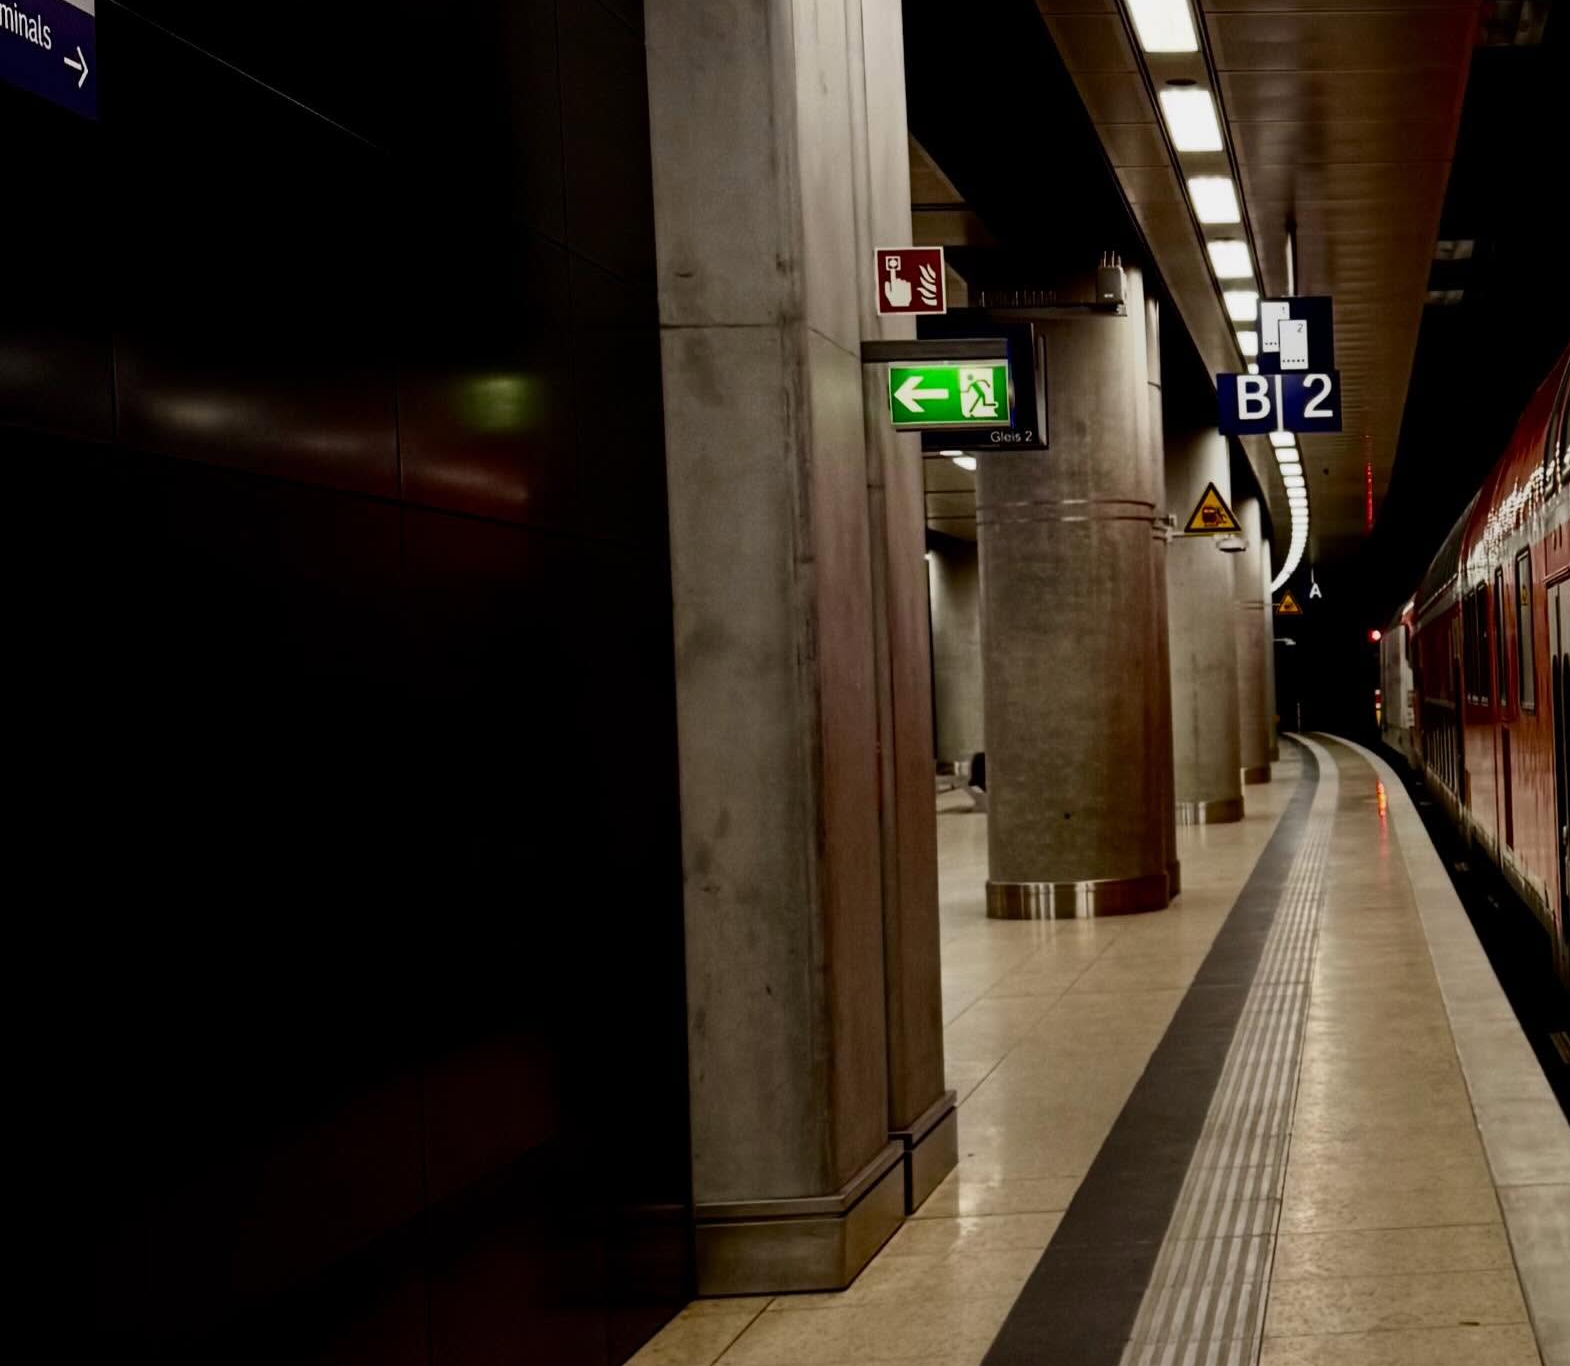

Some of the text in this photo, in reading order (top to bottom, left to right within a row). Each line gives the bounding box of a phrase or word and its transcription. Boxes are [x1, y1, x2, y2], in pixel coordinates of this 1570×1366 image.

[1297, 323, 1304, 334] 2
[1236, 373, 1334, 420] B 2
[1024, 430, 1033, 443] 2
[1309, 582, 1323, 600] A
